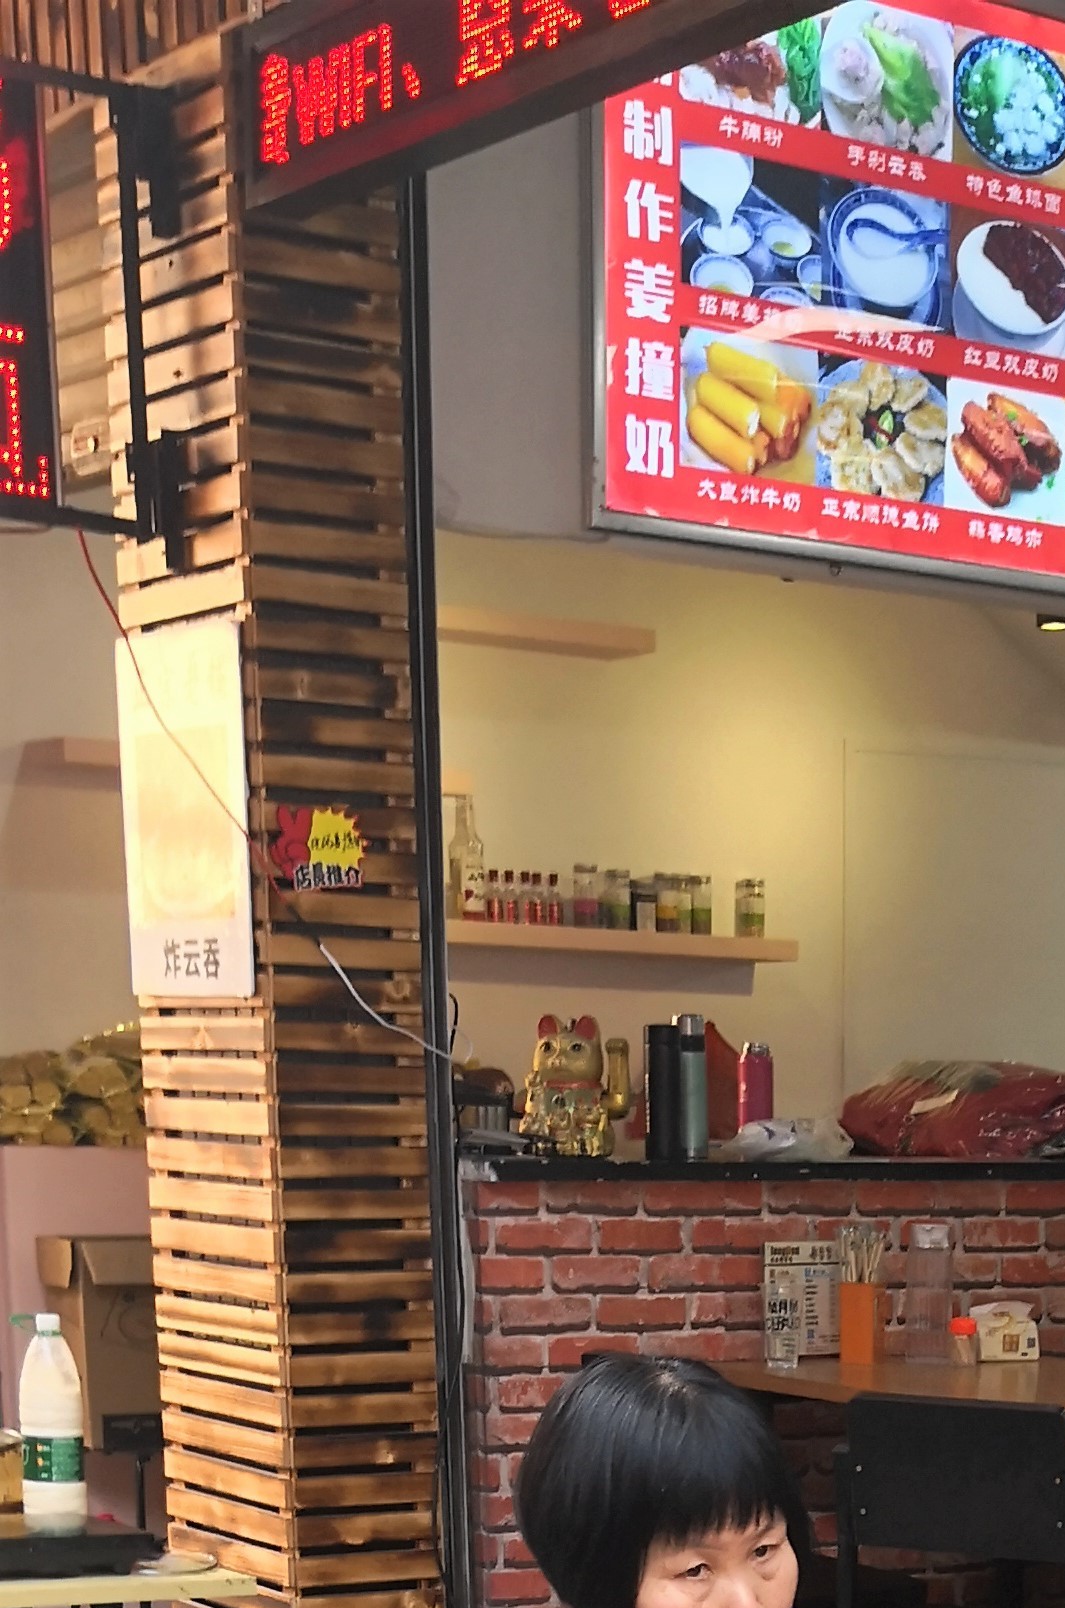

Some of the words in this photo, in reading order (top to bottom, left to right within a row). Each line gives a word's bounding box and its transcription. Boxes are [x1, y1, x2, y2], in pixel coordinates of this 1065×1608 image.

[719, 114, 784, 148] 牛腩粉
[623, 70, 675, 478] 制作姜撞奶
[834, 323, 936, 358] 正宗双皮奶
[963, 346, 1060, 383] 红豆双皮奶
[697, 477, 801, 513] 大良炸牛奶
[821, 497, 940, 534] 正宗顺德鱼饼
[163, 938, 220, 979] 炸云吞
